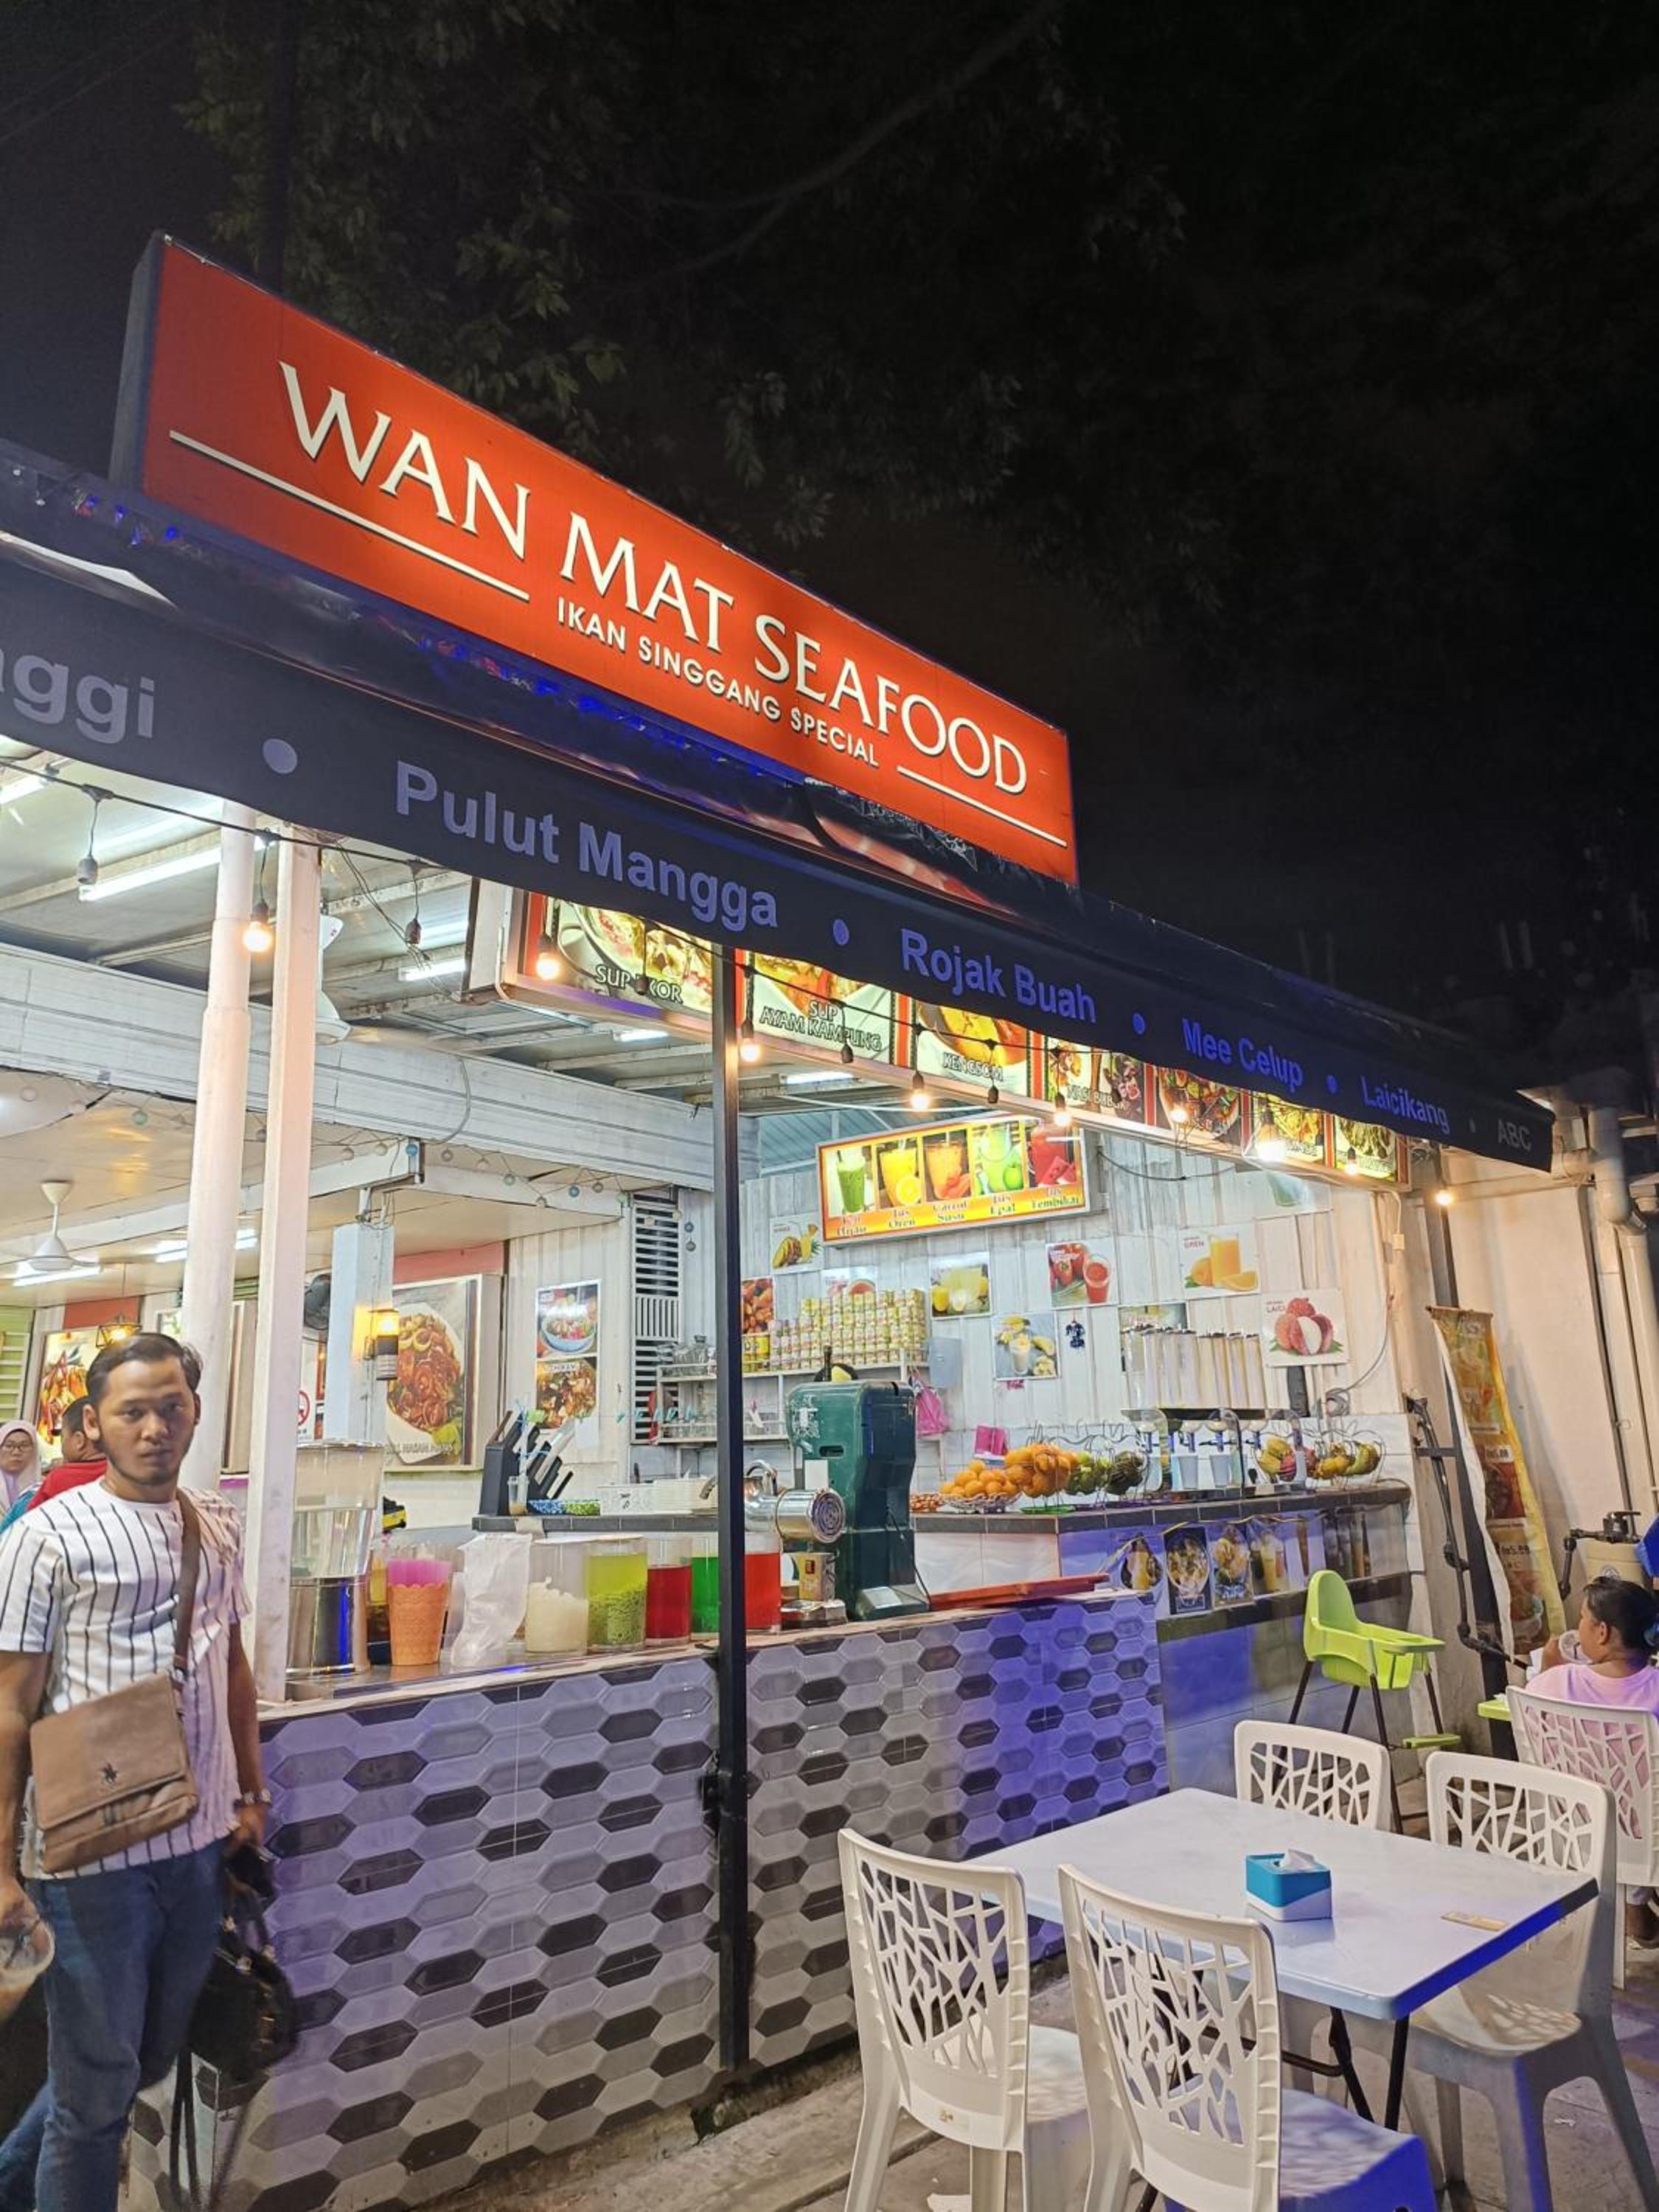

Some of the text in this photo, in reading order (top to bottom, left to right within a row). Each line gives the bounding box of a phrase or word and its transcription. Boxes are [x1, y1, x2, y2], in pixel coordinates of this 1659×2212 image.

[279, 361, 1027, 793] WAN MAT SEAFOOD
[0, 648, 155, 744] ggi
[557, 597, 879, 766] IKAN SINGGANG SPECIAL
[396, 760, 778, 932] Pulut Mangga
[596, 964, 631, 989] SUP
[808, 999, 839, 1022] SUP
[901, 927, 1096, 1023] Rojak Buah
[759, 1006, 883, 1051] AYAM KAMPUNG
[1183, 1018, 1304, 1092] Mee Celup
[1362, 1076, 1450, 1135] Laicikang
[1497, 1118, 1532, 1152] ABC
